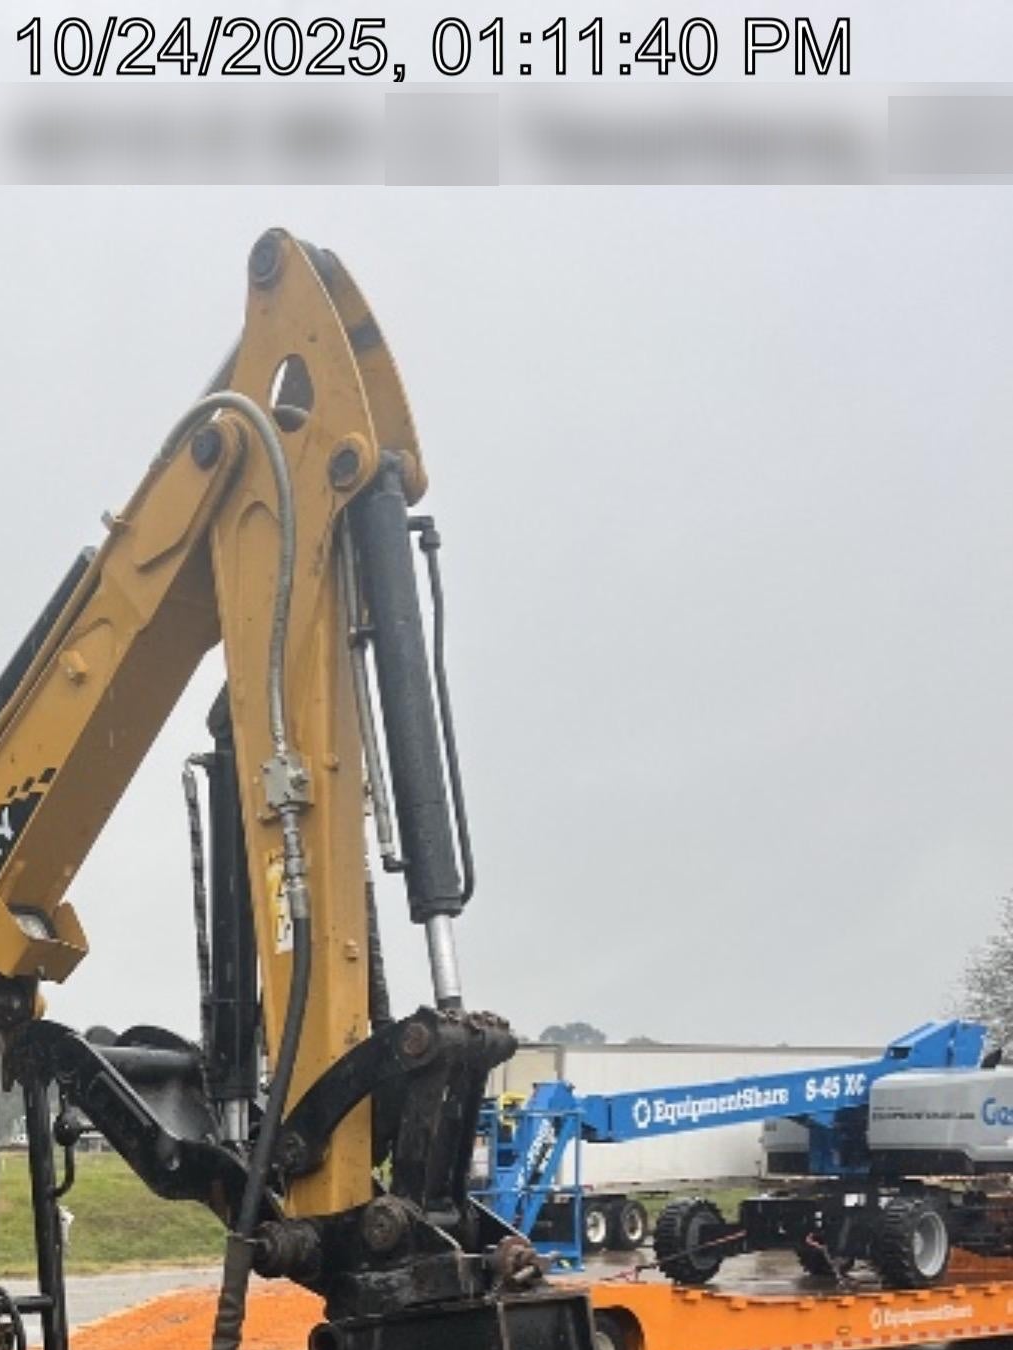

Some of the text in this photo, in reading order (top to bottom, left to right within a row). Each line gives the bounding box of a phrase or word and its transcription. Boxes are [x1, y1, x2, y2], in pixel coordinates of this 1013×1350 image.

[653, 1072, 867, 1125] EquipmentShare S-45 XC
